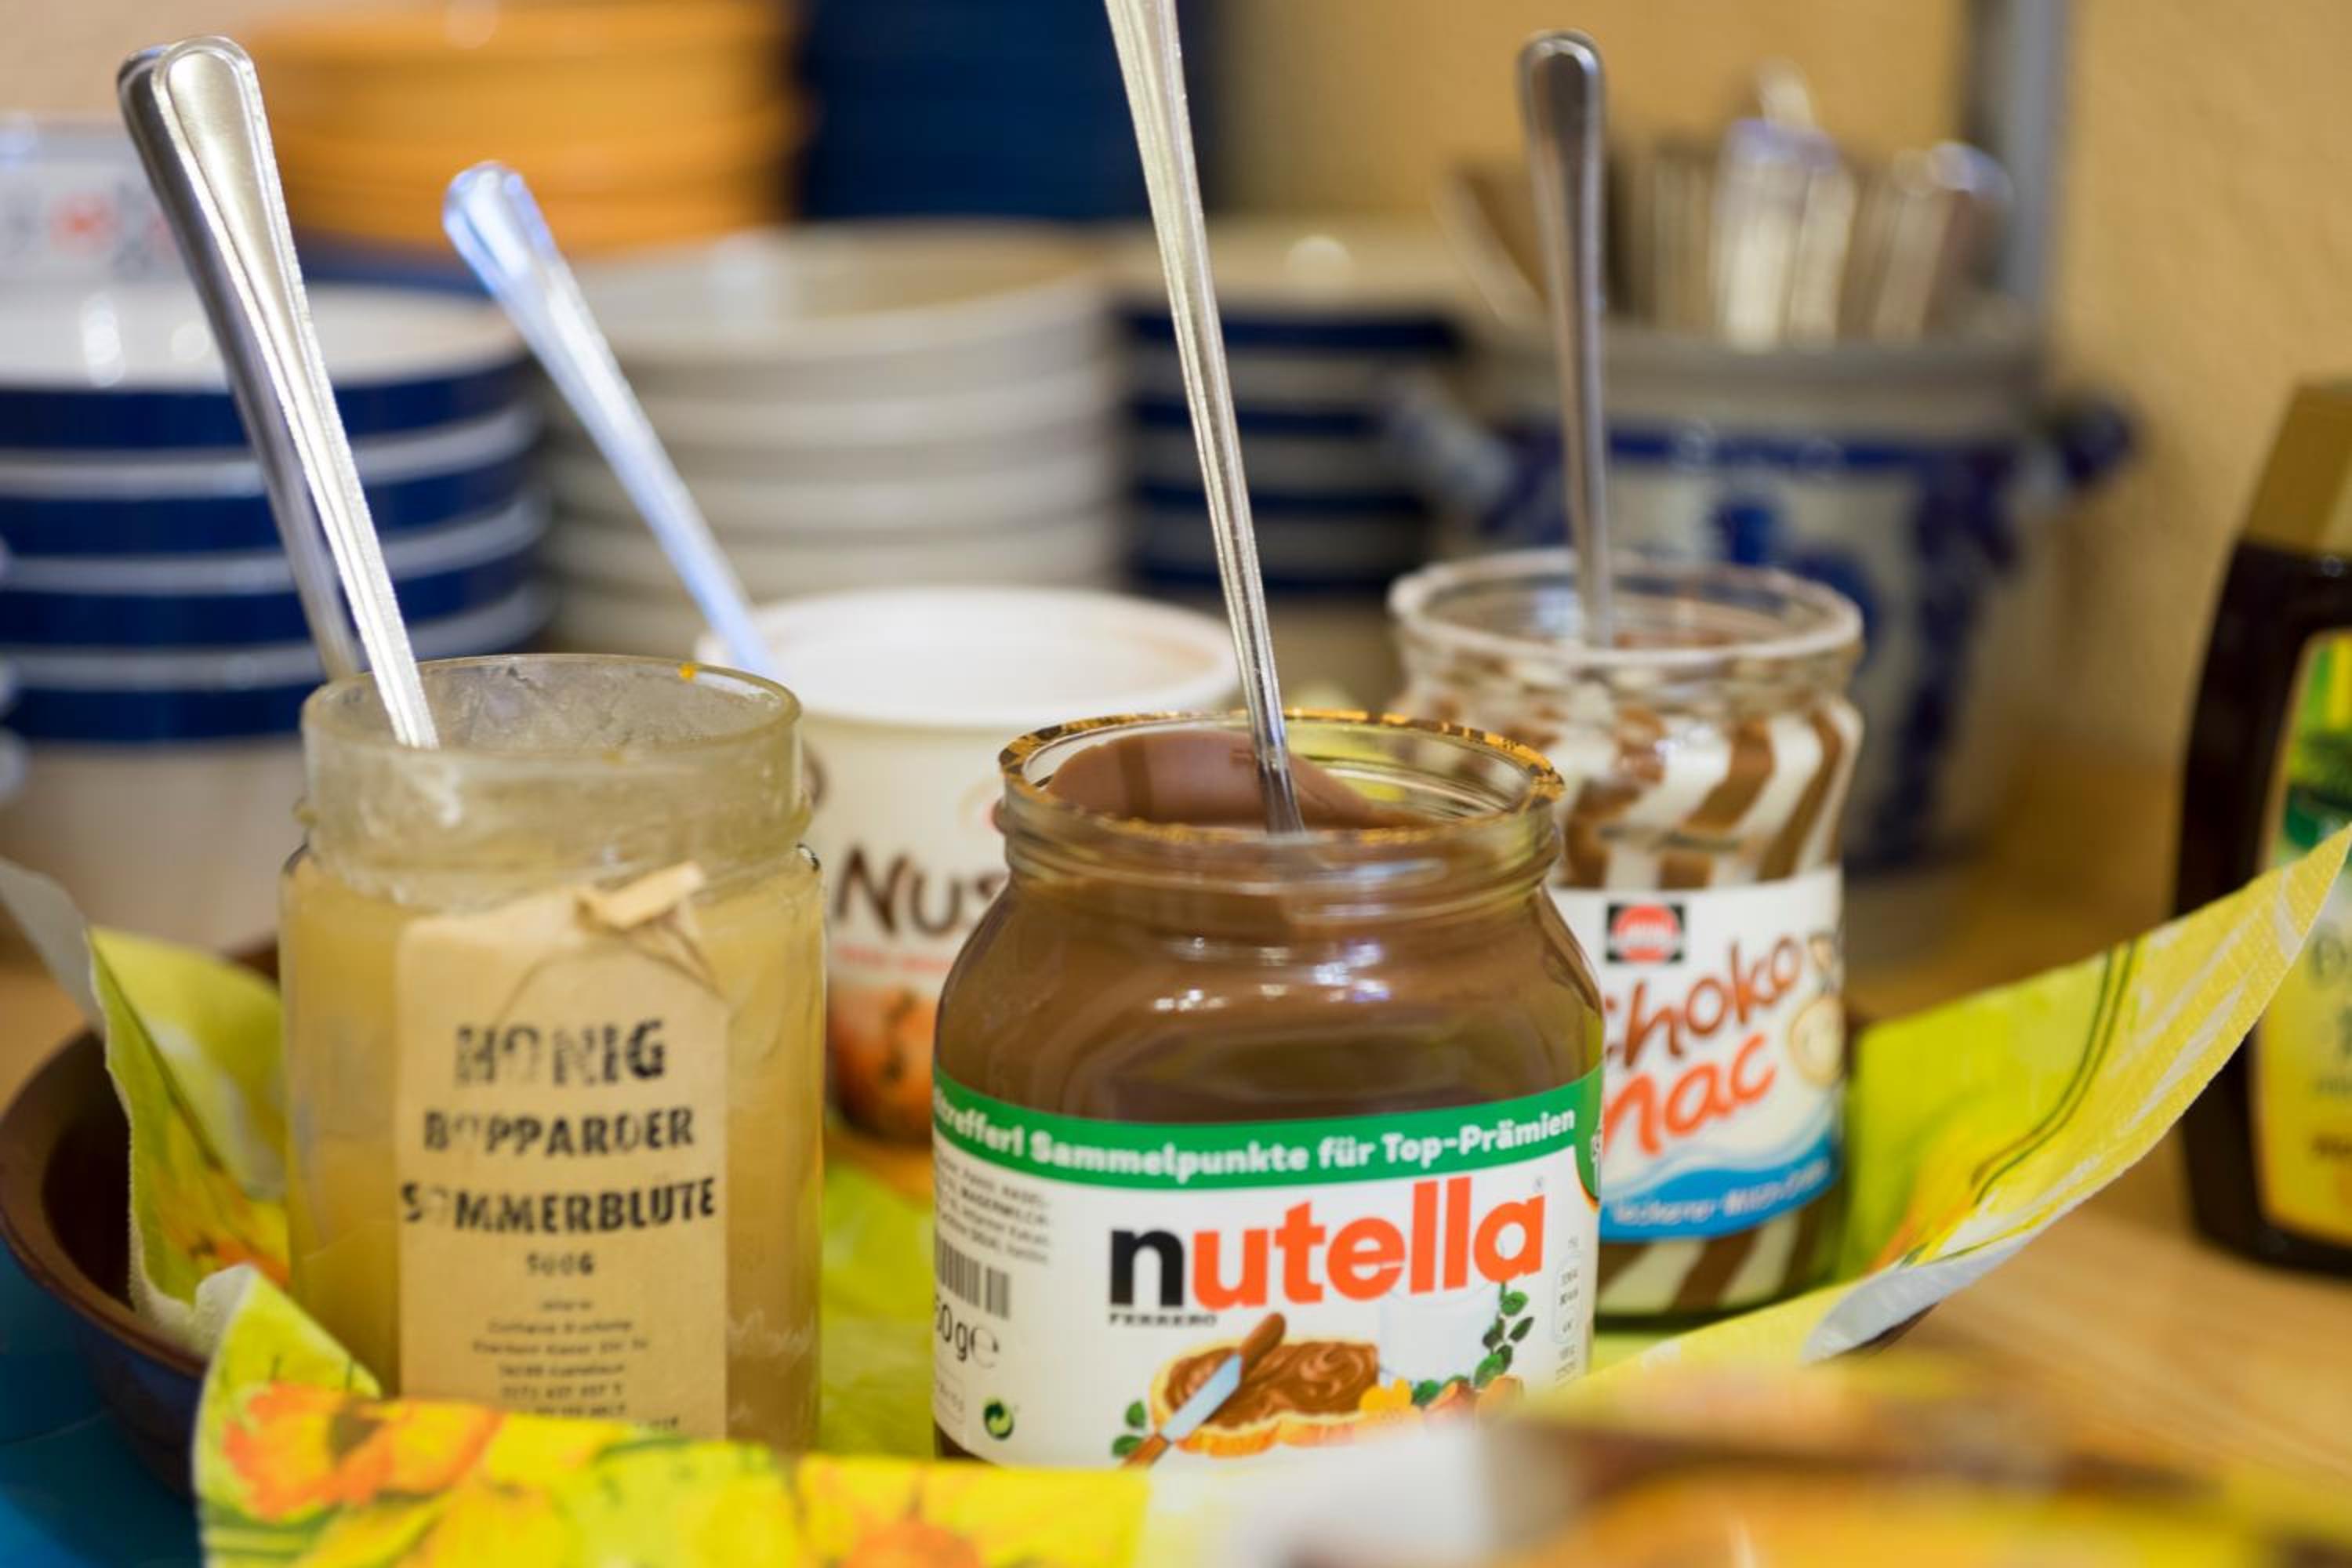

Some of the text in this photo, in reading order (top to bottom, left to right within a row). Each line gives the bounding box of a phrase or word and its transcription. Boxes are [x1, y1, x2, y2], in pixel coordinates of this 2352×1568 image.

[1029, 1130, 1310, 1185] Sammelpunkte
[1318, 1136, 1375, 1170] für
[1381, 1109, 1576, 1169] Top-Prämien
[1110, 1175, 1545, 1312] nutella
